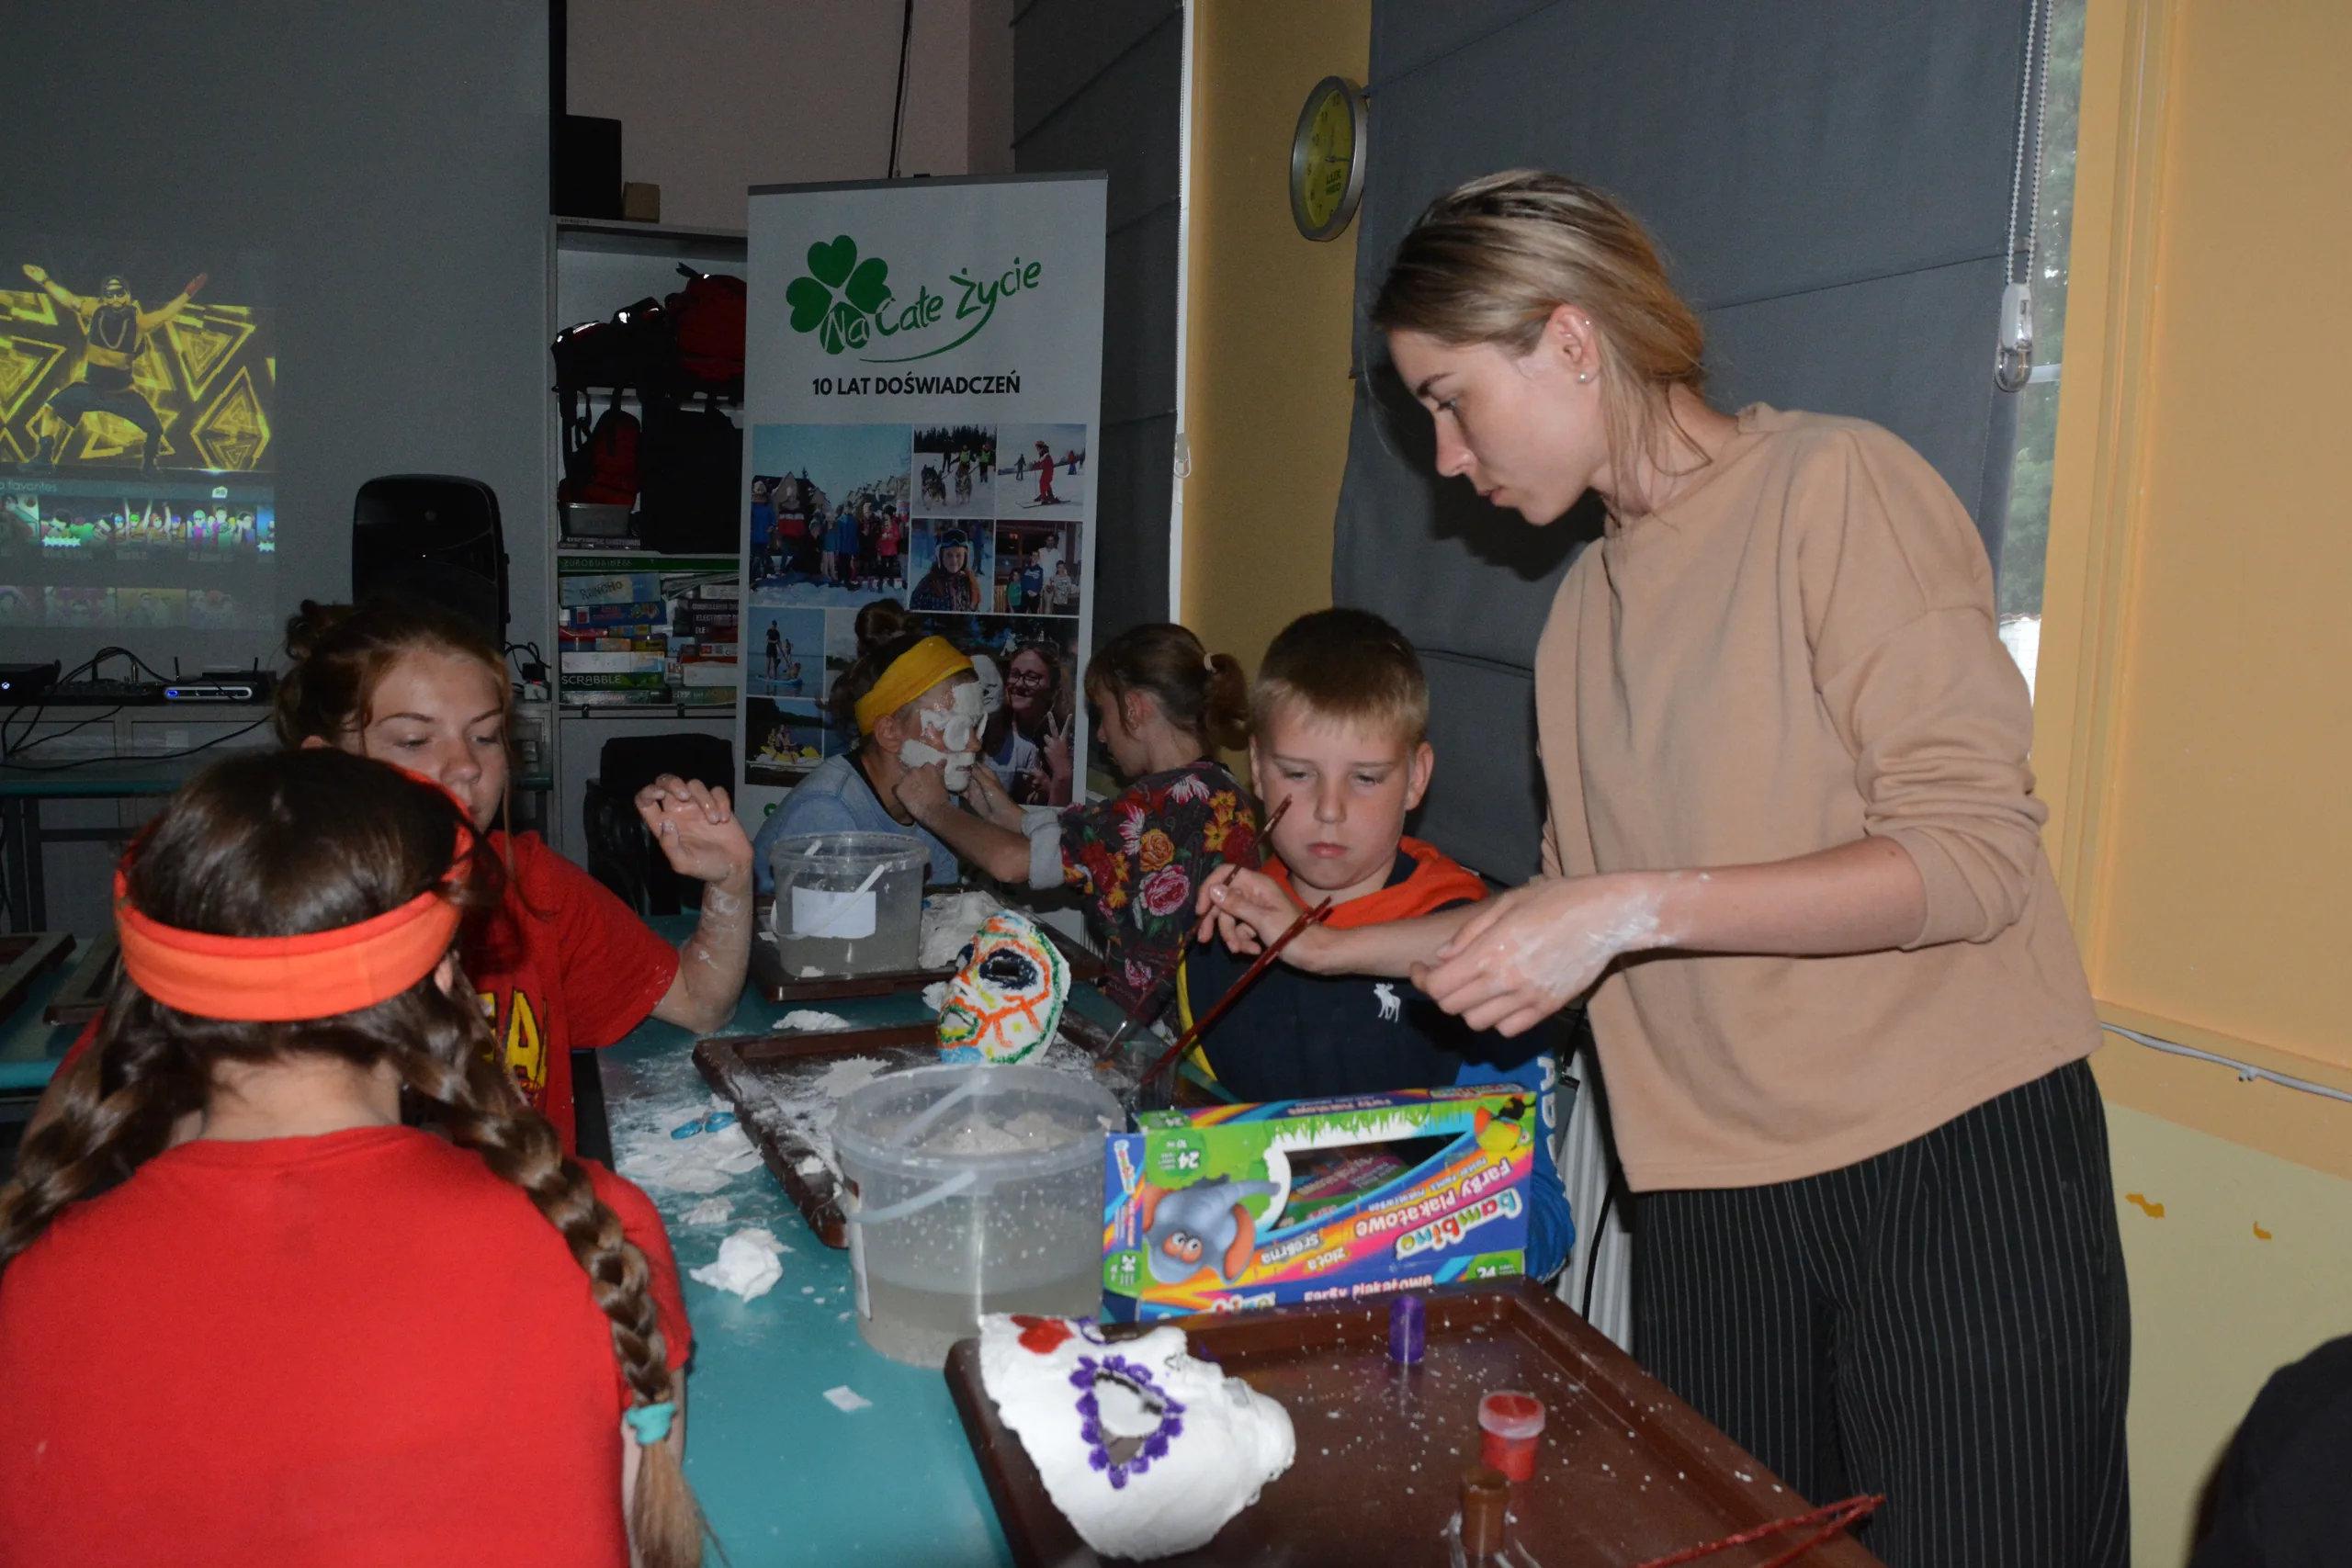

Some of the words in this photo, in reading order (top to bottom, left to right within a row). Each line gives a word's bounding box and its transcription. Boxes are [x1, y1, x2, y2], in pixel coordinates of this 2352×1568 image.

[823, 308, 870, 351] Na
[949, 256, 1042, 321] Życie
[812, 377, 832, 395] 10
[838, 377, 870, 395] LAT
[875, 370, 1020, 395] DOŚWIADCZEŃ
[561, 675, 622, 686] SCRABBLE
[1178, 1151, 1200, 1169] 24
[1353, 1189, 1457, 1237] Plakatowe
[1398, 1190, 1518, 1252] bambino
[1476, 1265, 1497, 1280] 24
